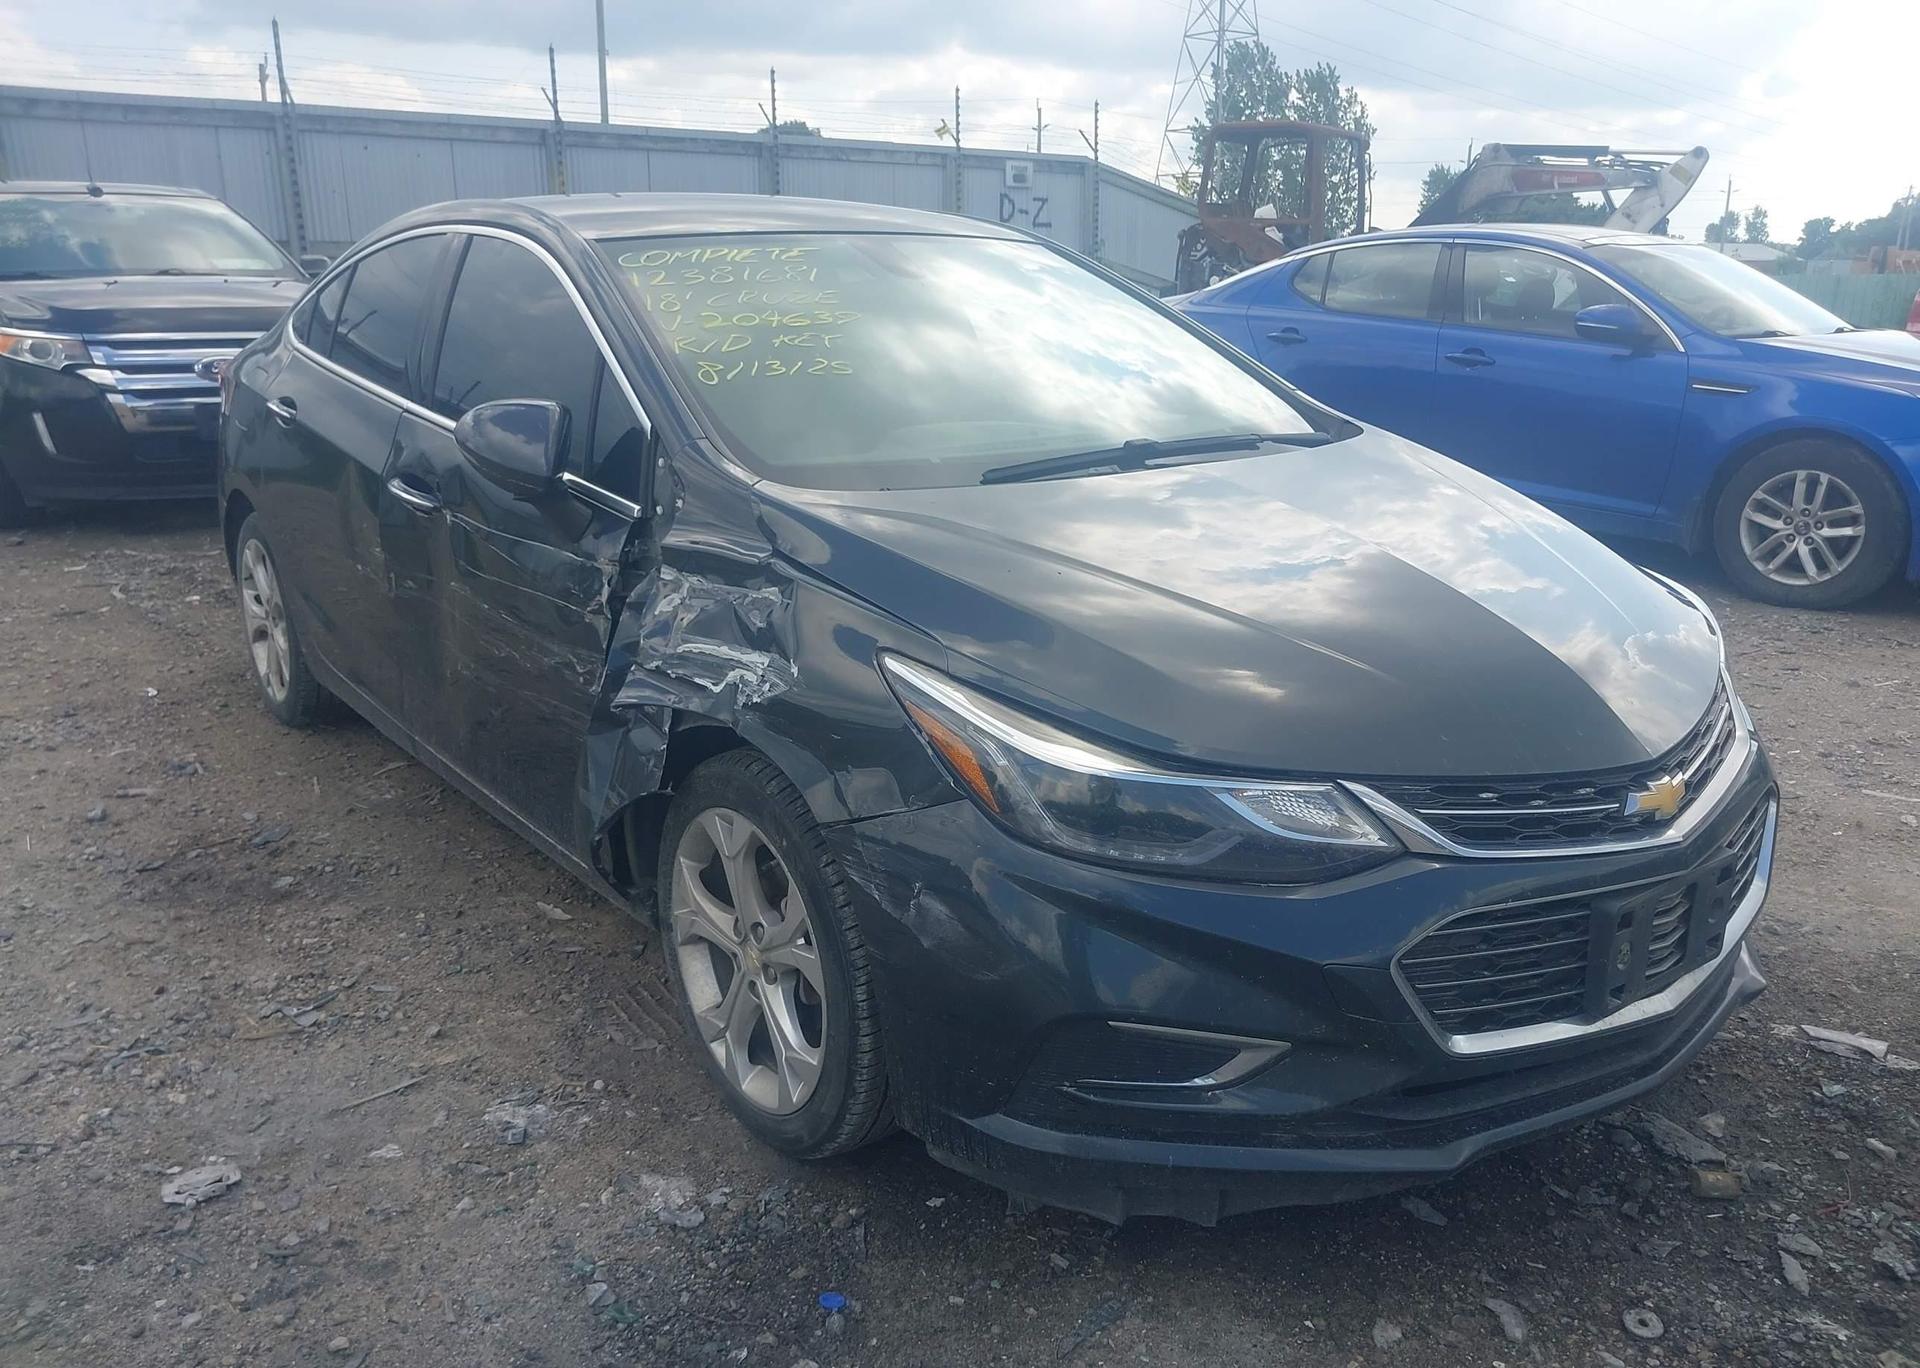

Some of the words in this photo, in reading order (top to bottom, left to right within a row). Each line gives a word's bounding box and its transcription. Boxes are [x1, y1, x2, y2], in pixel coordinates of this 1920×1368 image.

[999, 193, 1052, 228] D-Z
[629, 265, 818, 287] 12381681
[706, 290, 840, 307] CRUZE
[697, 358, 853, 385] 8/13/25
